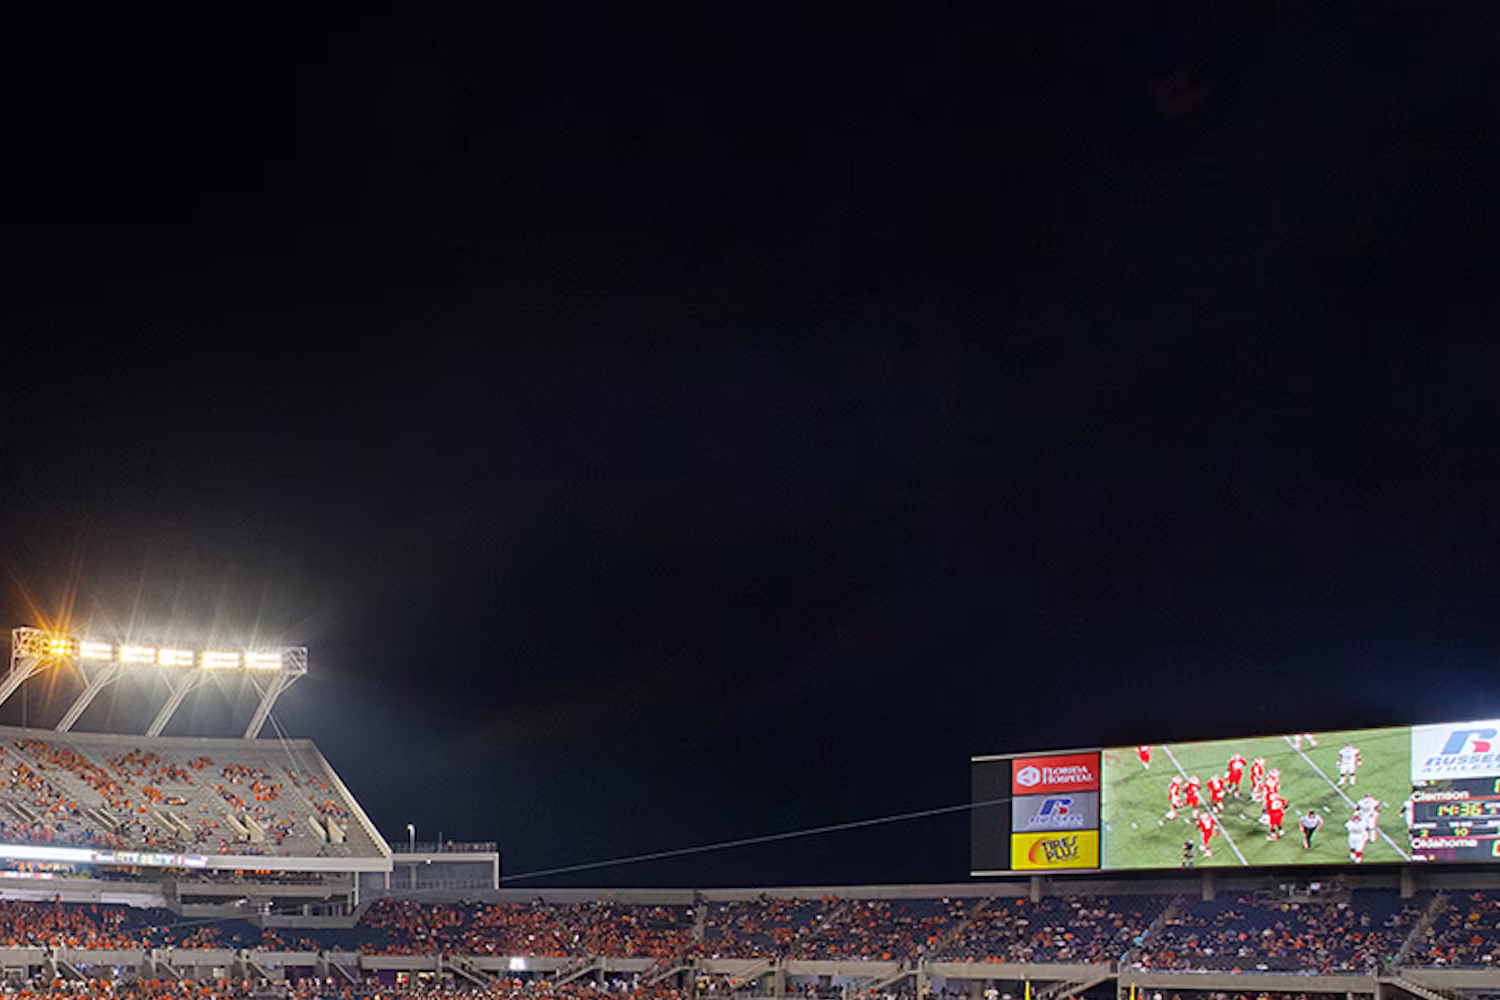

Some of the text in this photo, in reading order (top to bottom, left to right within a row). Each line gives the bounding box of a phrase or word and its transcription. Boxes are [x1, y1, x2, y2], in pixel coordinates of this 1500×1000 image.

[1042, 835, 1077, 851] TIRES
[1411, 838, 1478, 849] Oklahoma
[1045, 846, 1079, 862] PLUS
